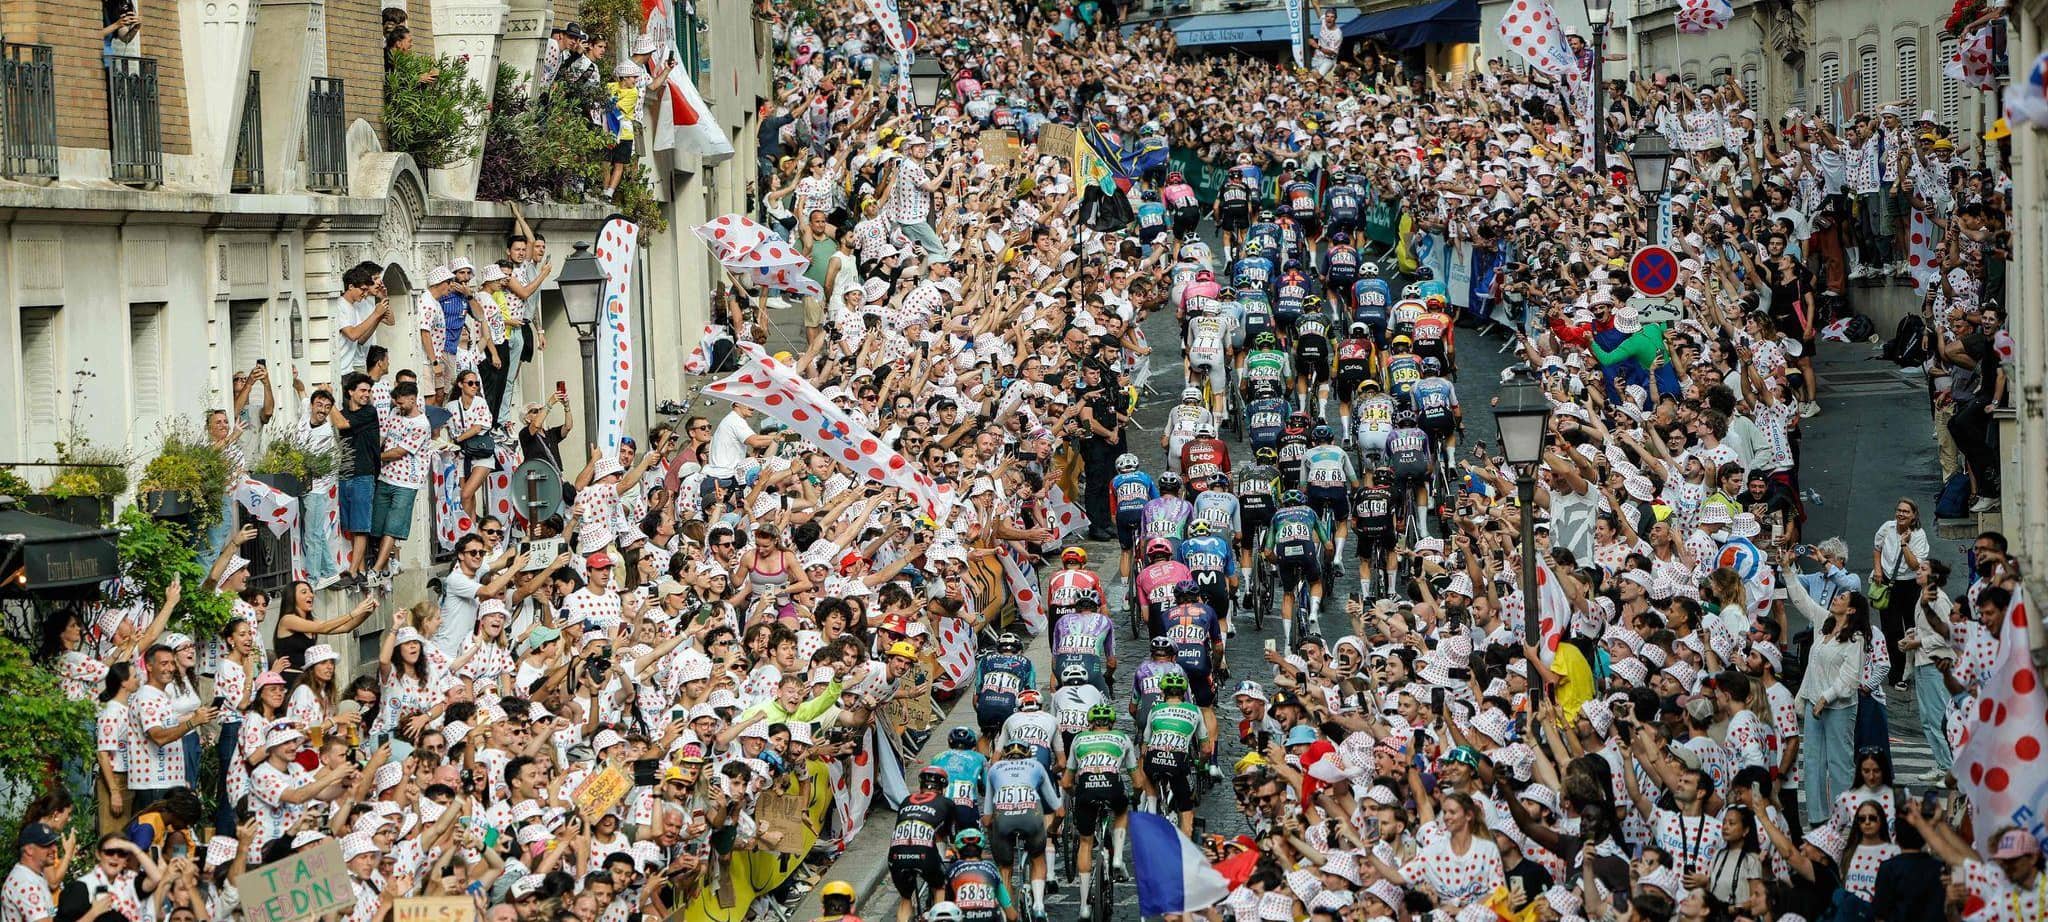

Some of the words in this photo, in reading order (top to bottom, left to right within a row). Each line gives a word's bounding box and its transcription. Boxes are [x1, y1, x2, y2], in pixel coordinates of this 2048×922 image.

[1396, 370, 1405, 380] 35
[1409, 369, 1418, 379] 35
[1365, 410, 1374, 419] 34
[1378, 410, 1388, 419] 34
[1315, 470, 1326, 480] 68
[1332, 470, 1343, 480] 68
[1282, 526, 1293, 537] 98
[1296, 525, 1307, 536] 98
[531, 542, 551, 552] SAUF
[1153, 588, 1163, 598] 48
[1187, 627, 1204, 639] 216
[986, 673, 997, 686] 76
[1157, 751, 1173, 760] CAJA
[1151, 758, 1178, 767] RURAL
[1088, 774, 1107, 782] CAJA
[1085, 781, 1113, 789] RURAL
[959, 784, 971, 798] 61
[997, 788, 1013, 803] 175
[1018, 788, 1036, 803] 175
[900, 804, 937, 816] TUDOR
[911, 825, 933, 842] 196
[960, 887, 977, 901] 58
[967, 909, 993, 920] Shine
